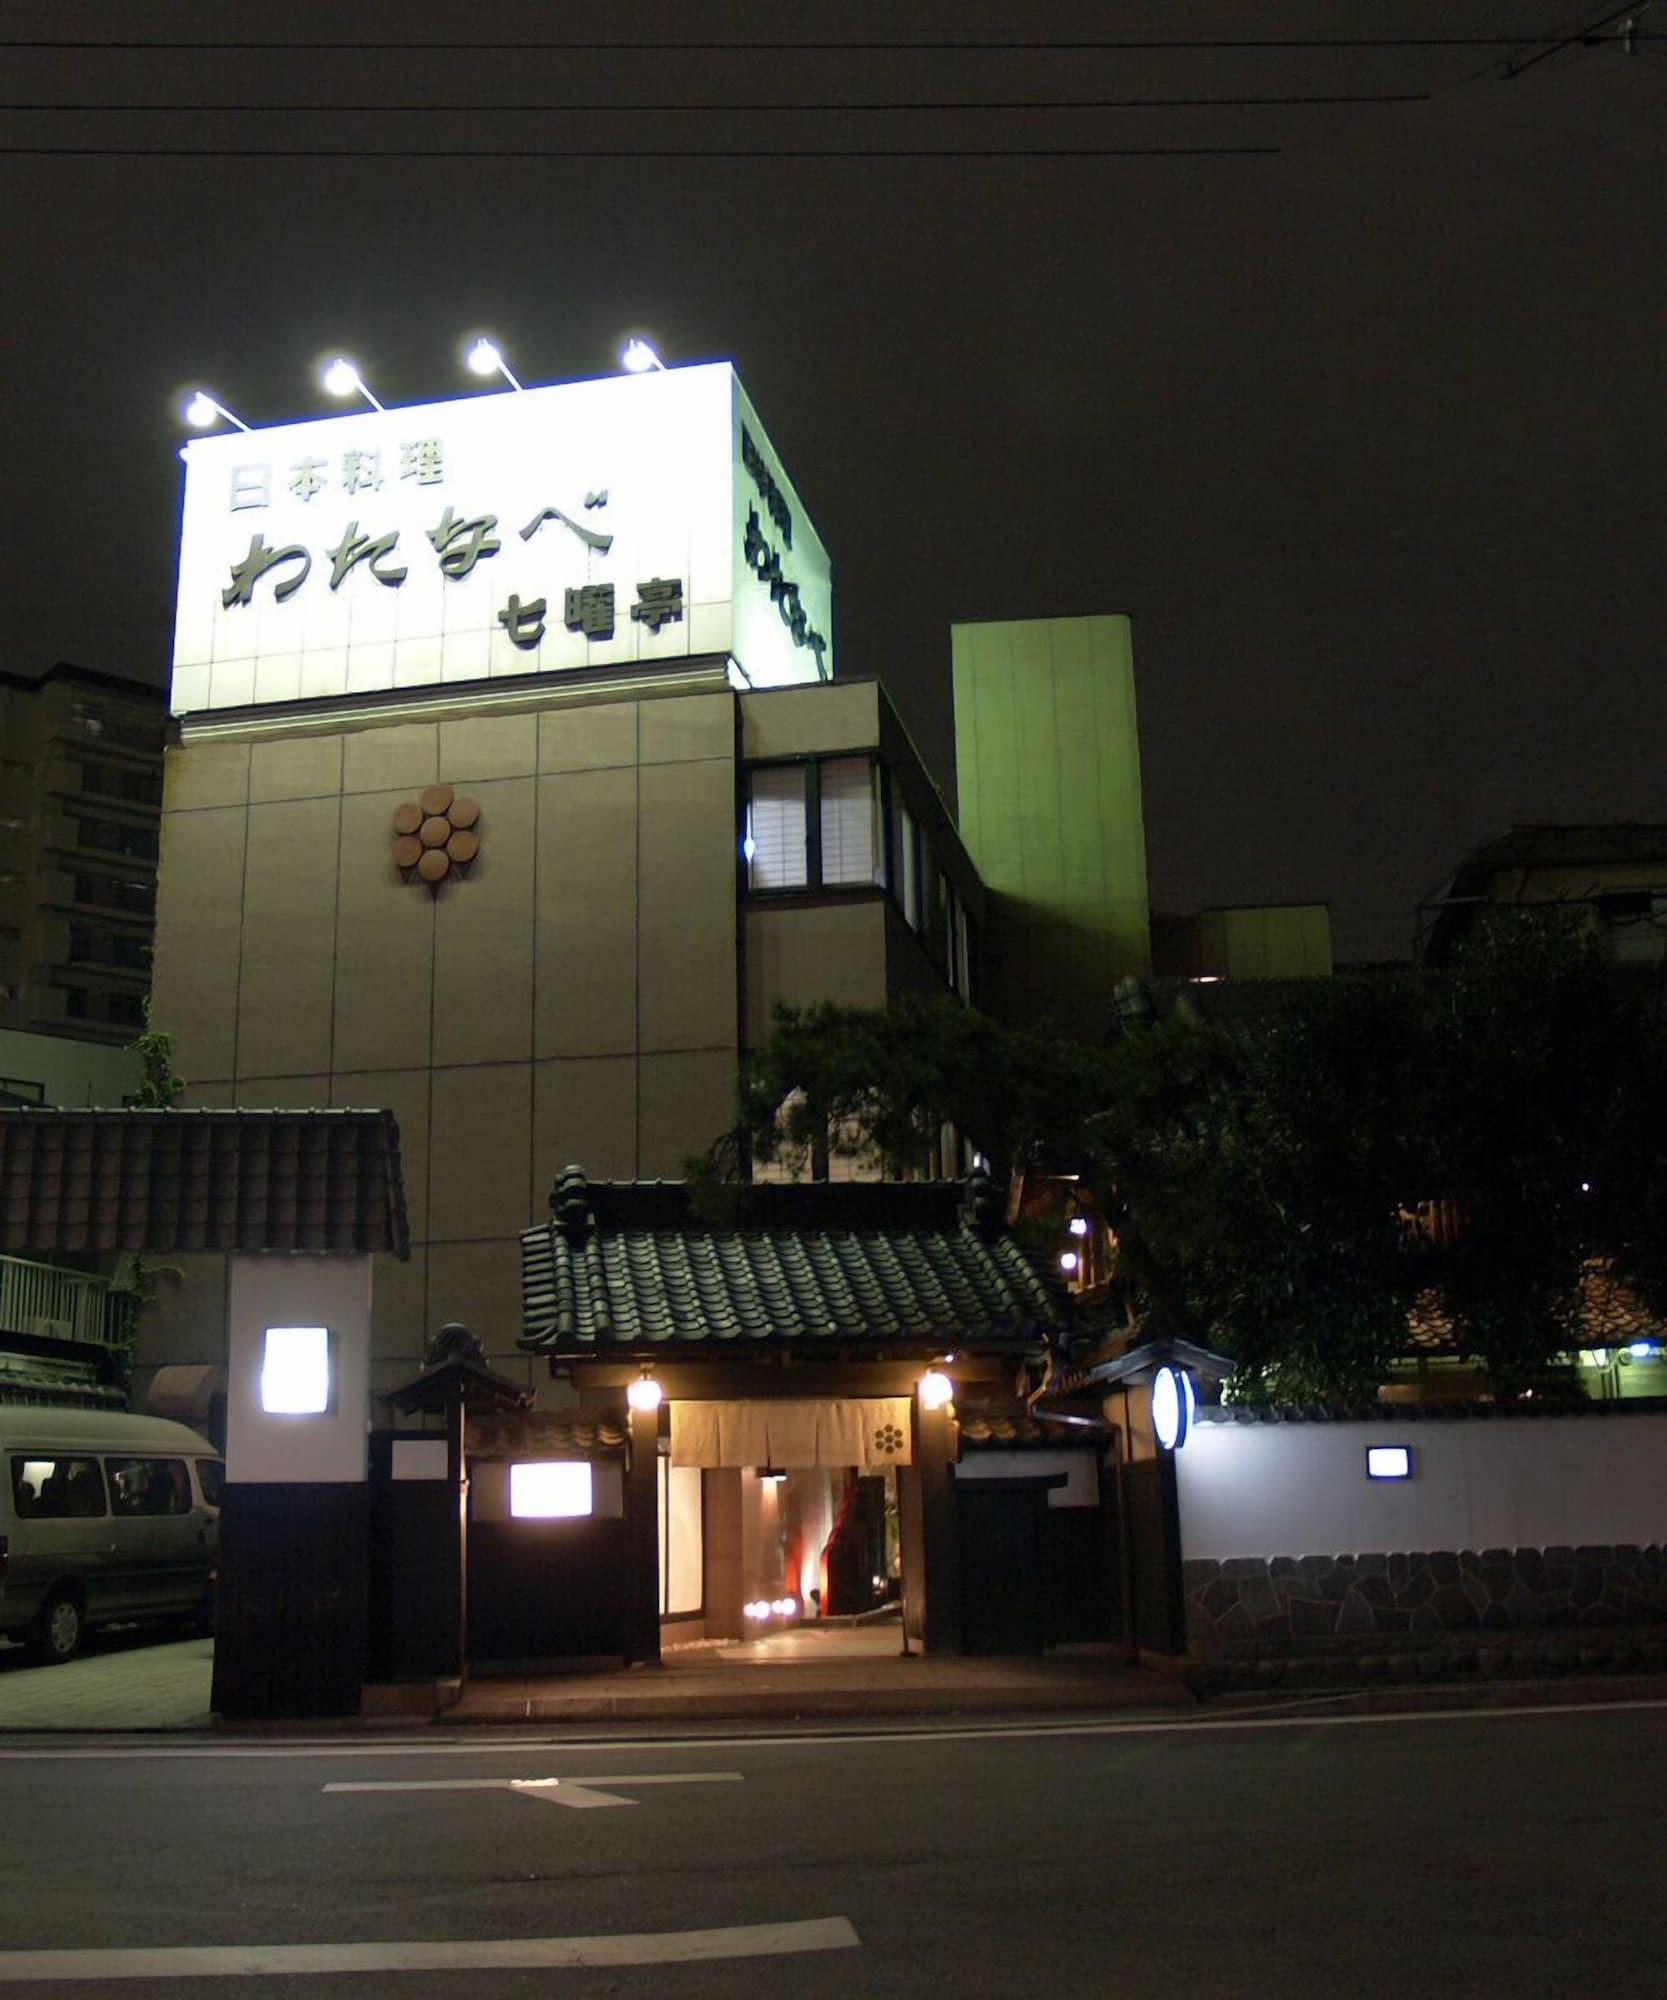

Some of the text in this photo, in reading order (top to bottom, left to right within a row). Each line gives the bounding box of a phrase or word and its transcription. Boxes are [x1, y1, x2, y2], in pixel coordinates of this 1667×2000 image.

[230, 438, 442, 512] 日本料理
[222, 490, 613, 609] わたなべ
[498, 577, 682, 650] 七曜亭
